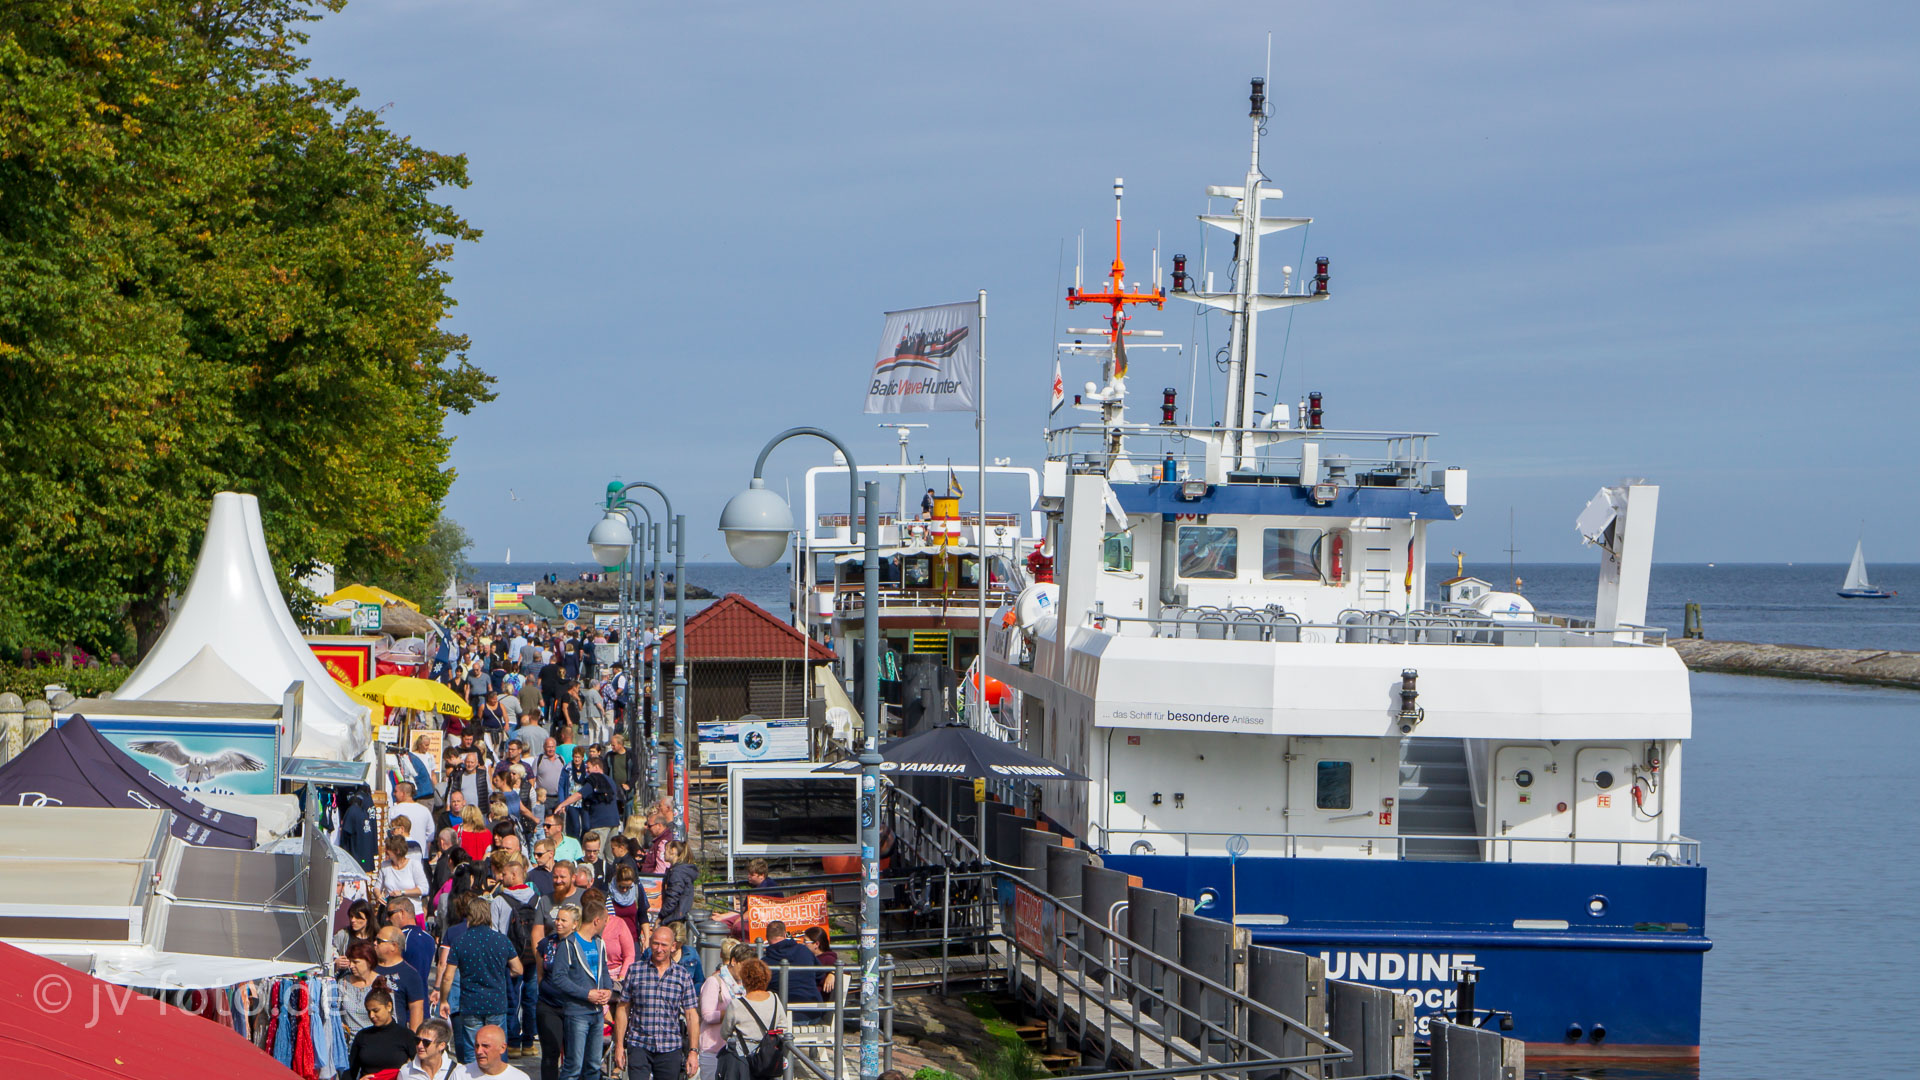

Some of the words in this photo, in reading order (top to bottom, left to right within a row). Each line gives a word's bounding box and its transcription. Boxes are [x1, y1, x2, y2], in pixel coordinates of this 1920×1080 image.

[441, 702, 460, 714] ADAC
[1112, 710, 1128, 719] das
[1129, 710, 1152, 720] Schiff
[1154, 711, 1165, 721] für
[1167, 710, 1230, 724] besondere
[1231, 715, 1265, 725] Anlässe
[899, 762, 966, 773] YAMAHA
[1003, 765, 1065, 776] YAMAHA
[750, 902, 827, 921] GUTSCHEINE
[1320, 951, 1476, 982] UNDINE
[1392, 988, 1458, 1009] OCK
